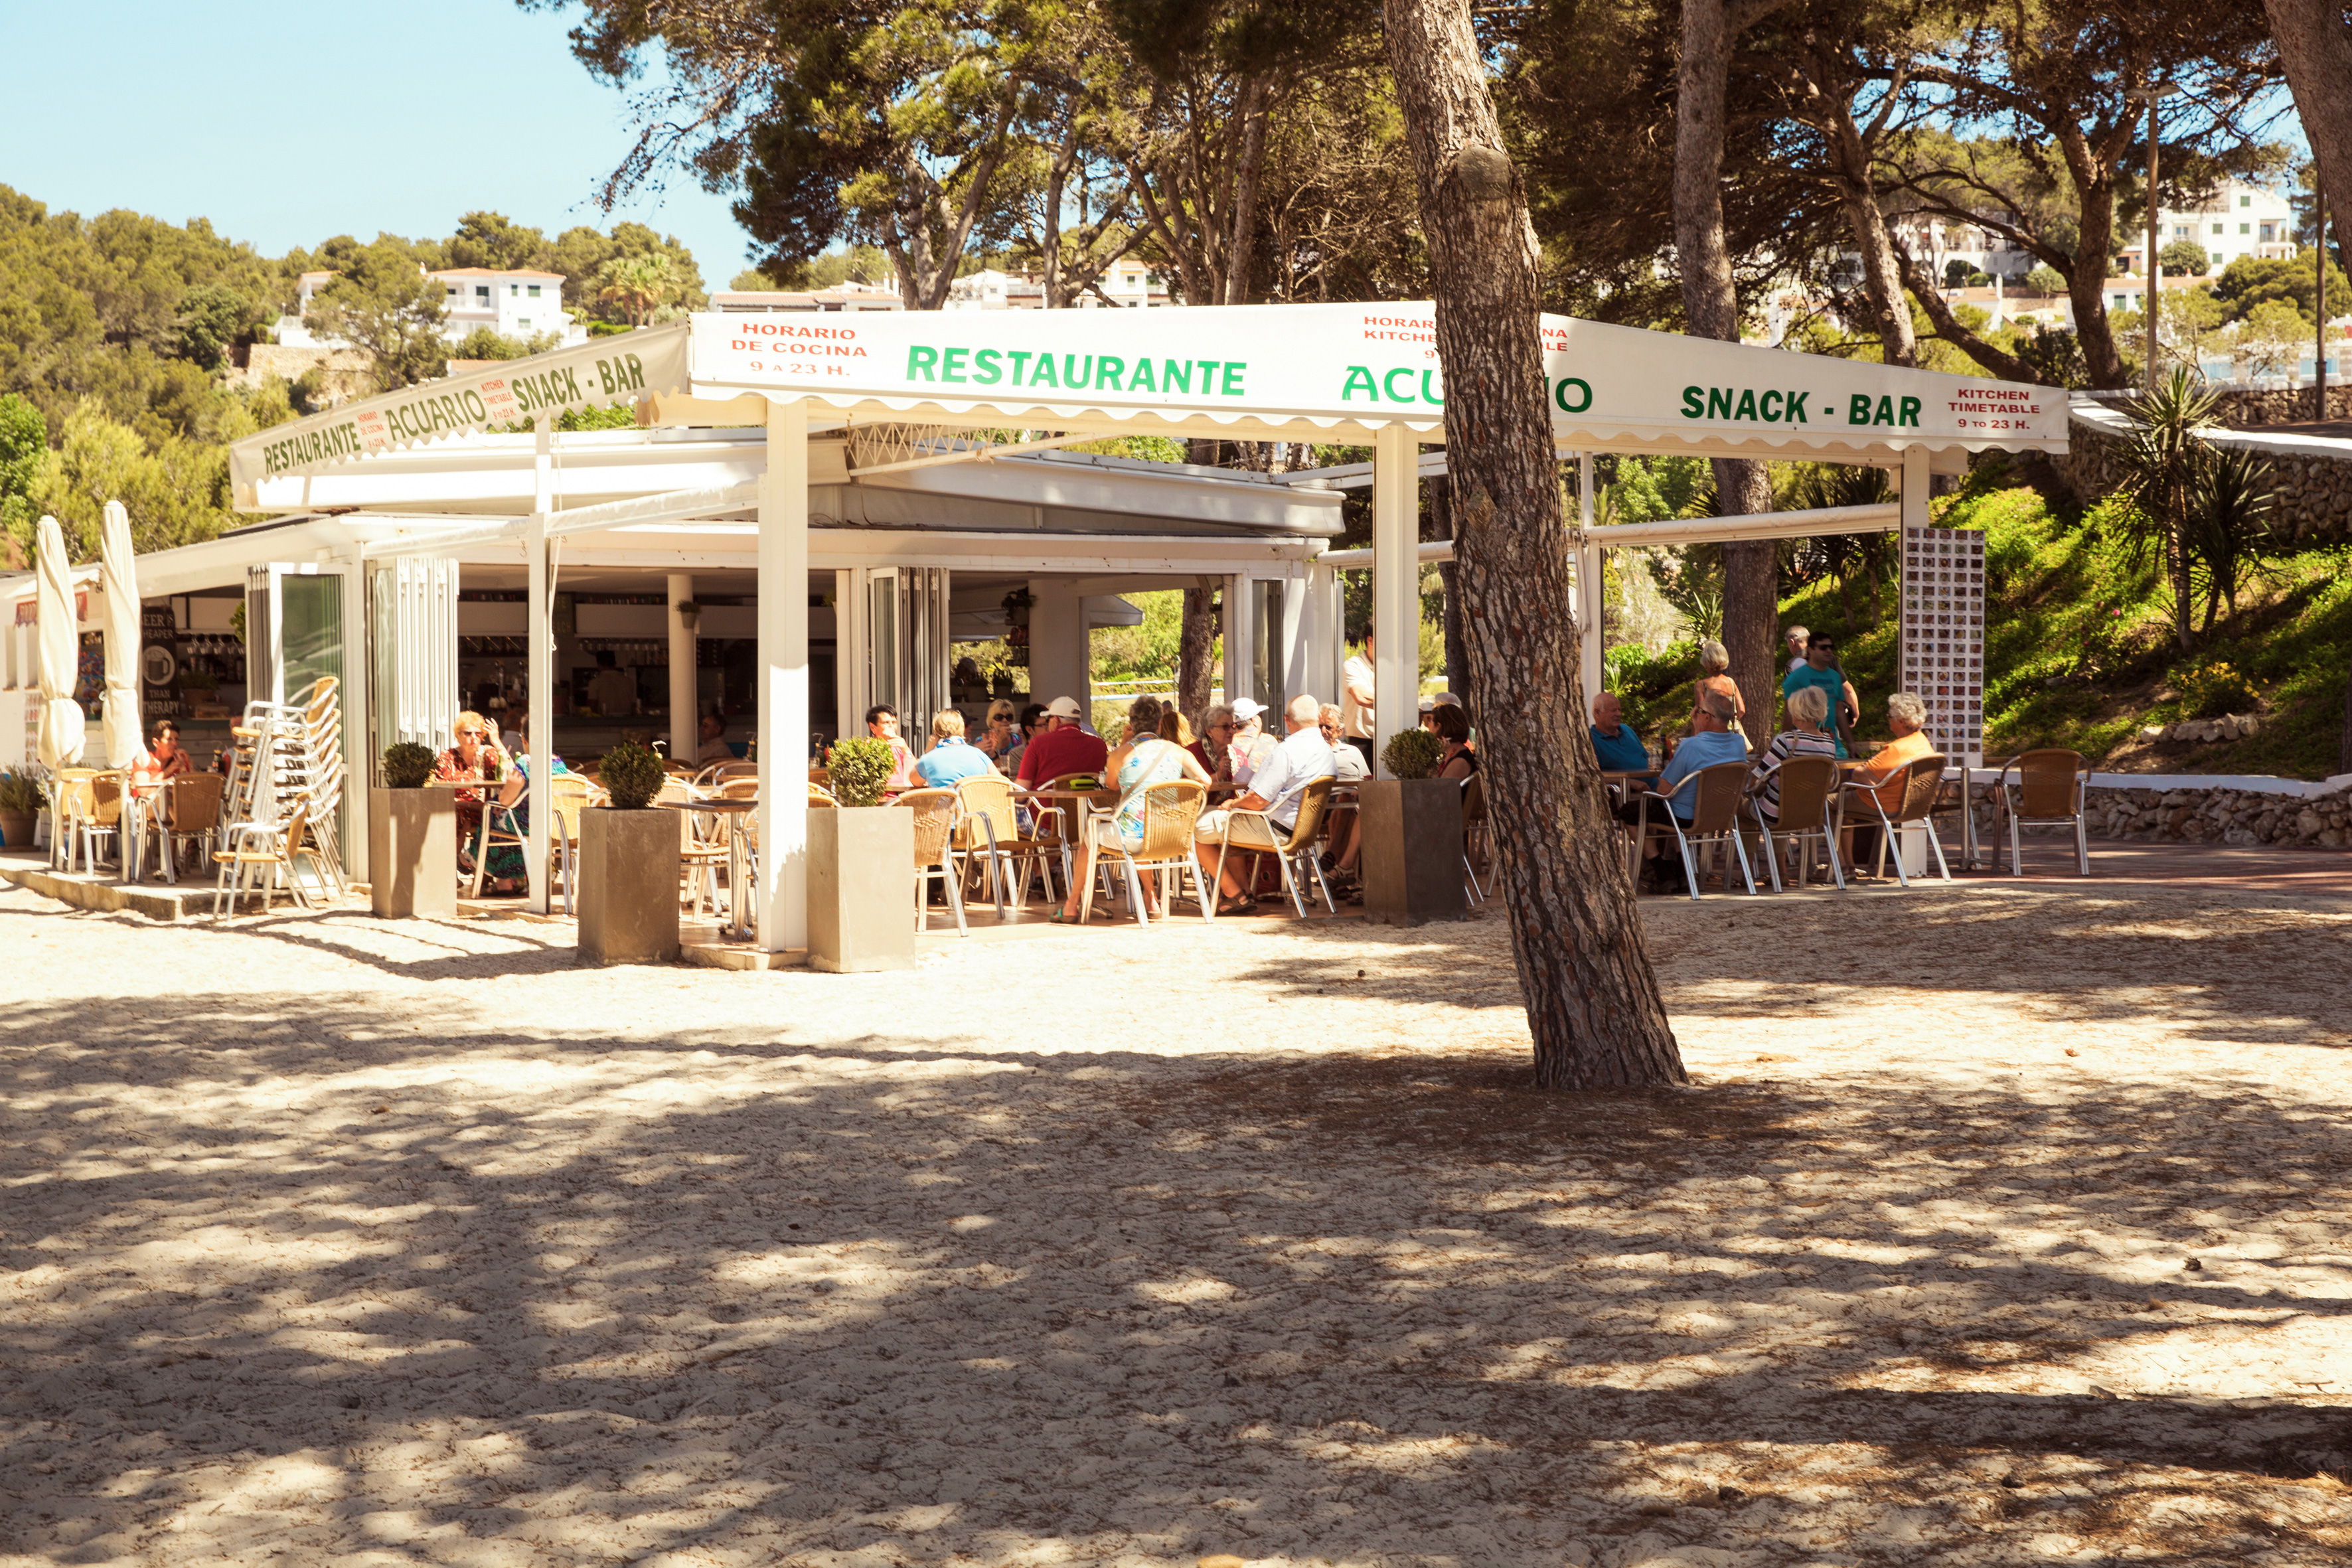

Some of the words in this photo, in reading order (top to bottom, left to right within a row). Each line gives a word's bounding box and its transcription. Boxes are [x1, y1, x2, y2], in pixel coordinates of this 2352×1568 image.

[1364, 317, 1435, 329] HORAR
[743, 323, 856, 340] HORARIO
[1364, 331, 1437, 343] KITCHE
[732, 340, 763, 352] DE
[773, 343, 868, 356] COCINA
[1425, 350, 1435, 359] 9
[750, 361, 763, 372] 9
[790, 363, 817, 374] 23
[827, 365, 850, 376] H.
[480, 378, 505, 392] KITCHEN
[906, 345, 1247, 396] RESTAURANTE
[1342, 366, 1593, 413] ACUO
[1680, 386, 1810, 424] SNACK
[1849, 394, 1922, 427] BAR
[483, 392, 513, 406] TIMETABLE
[1958, 389, 2029, 400] KITCHEN
[264, 422, 362, 475] RESTAURANTE
[384, 390, 486, 441] ACUARIO
[512, 366, 582, 412] SNACK
[595, 353, 645, 395] BAR
[493, 411, 498, 420] 9
[502, 408, 509, 418] 23
[1948, 402, 2040, 414] TIMETABLE
[357, 411, 377, 423] HORARIO
[360, 427, 368, 435] DE
[366, 423, 384, 433] COCINA
[1958, 419, 1967, 428] 9
[1991, 420, 2009, 429] 23
[2015, 420, 2030, 430] H.
[143, 614, 165, 627] EER
[143, 629, 174, 639] HEAPER
[149, 690, 170, 698] THAN
[143, 701, 179, 714] THERAPY
